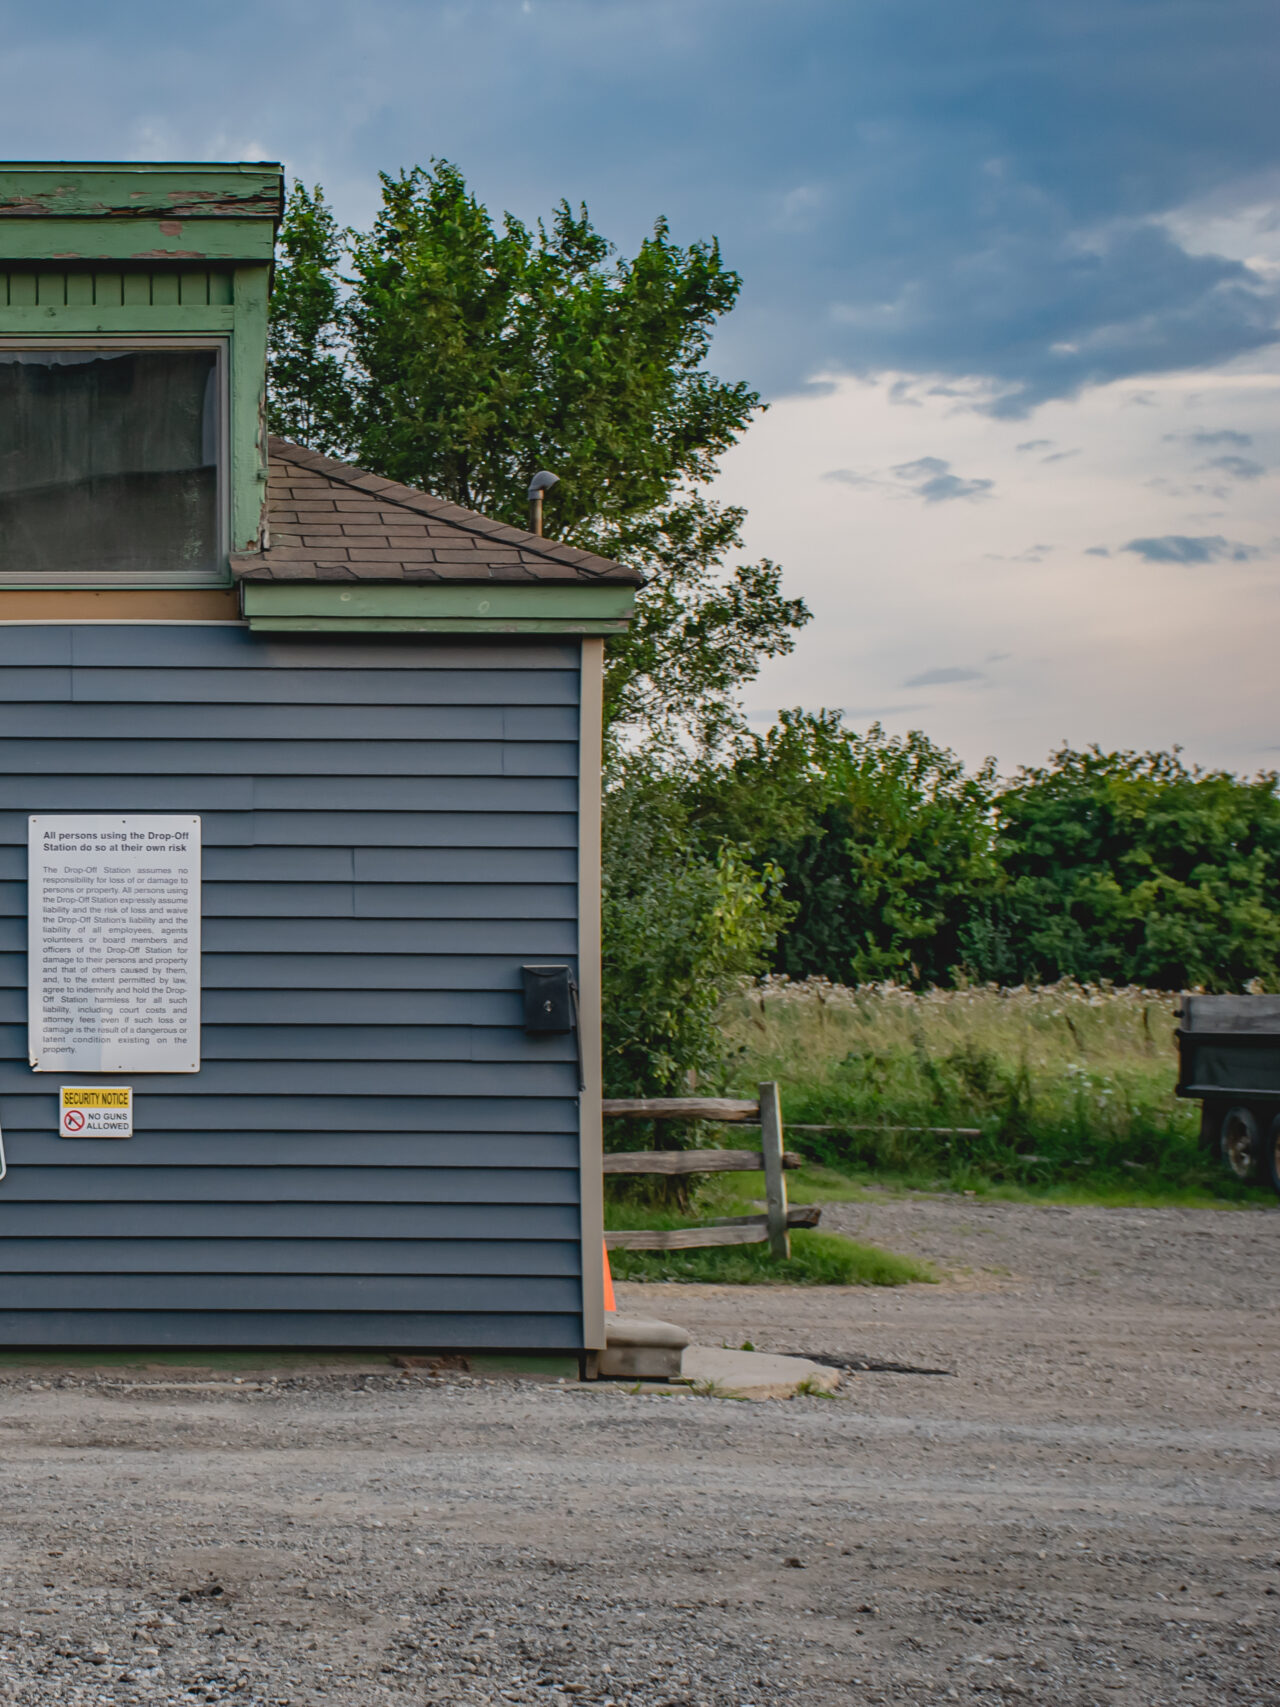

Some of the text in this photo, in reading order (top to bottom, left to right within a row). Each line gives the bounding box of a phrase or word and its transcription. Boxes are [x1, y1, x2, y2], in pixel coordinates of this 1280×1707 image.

[43, 831, 189, 841] All persons using the Drop-Off
[43, 844, 77, 852] Station
[80, 844, 92, 852] do
[109, 844, 118, 852] at
[121, 844, 143, 852] their
[168, 844, 187, 852] risk
[64, 867, 97, 875] Drop-Off
[43, 877, 94, 885] responsibility
[147, 877, 178, 885] damage
[167, 887, 188, 895] using
[56, 897, 90, 905] Drop-Off
[43, 907, 70, 915] liability
[58, 917, 91, 925] Drop-Off
[129, 917, 156, 925] liability
[43, 927, 71, 935] liability
[161, 927, 188, 935] agents
[107, 947, 140, 955] Drop-Off
[42, 957, 74, 965] damage
[155, 957, 188, 965] property
[153, 967, 161, 975] by
[118, 977, 155, 985] permitted
[159, 977, 169, 985] by
[76, 987, 114, 995] indemnify
[166, 987, 187, 995] Drop-
[77, 1007, 113, 1015] including
[42, 1017, 74, 1025] attorney
[42, 1027, 74, 1035] damage
[136, 1027, 177, 1035] dangerous
[118, 1037, 150, 1045] existing
[65, 1093, 128, 1104] SECURITY NOTICE
